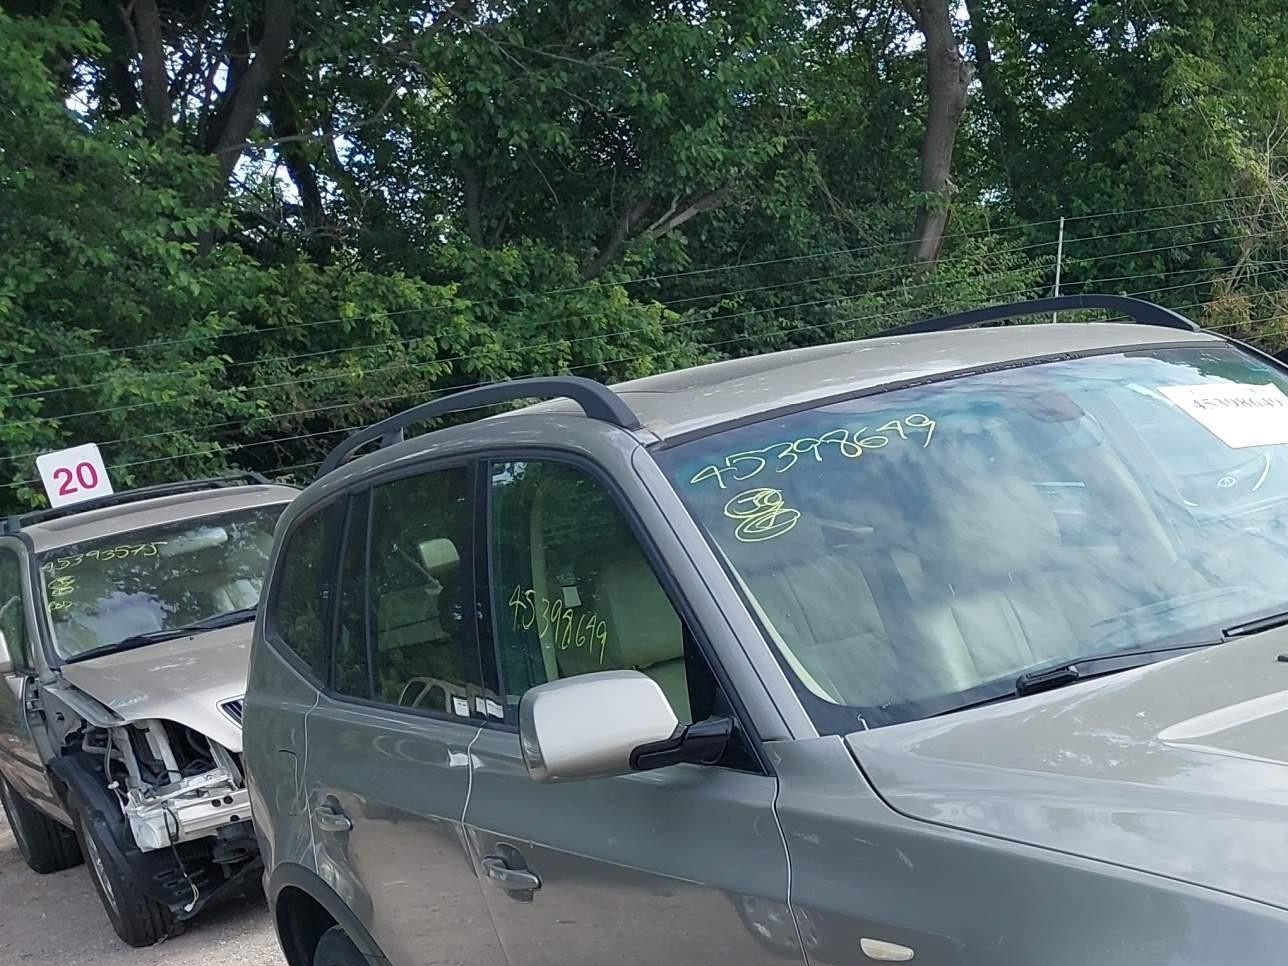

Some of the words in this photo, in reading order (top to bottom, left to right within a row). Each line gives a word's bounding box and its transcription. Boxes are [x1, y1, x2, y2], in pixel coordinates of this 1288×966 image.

[52, 461, 99, 497] 20
[690, 413, 936, 489] 45398649
[41, 541, 168, 573] 45393575
[508, 584, 608, 665] 45398649
